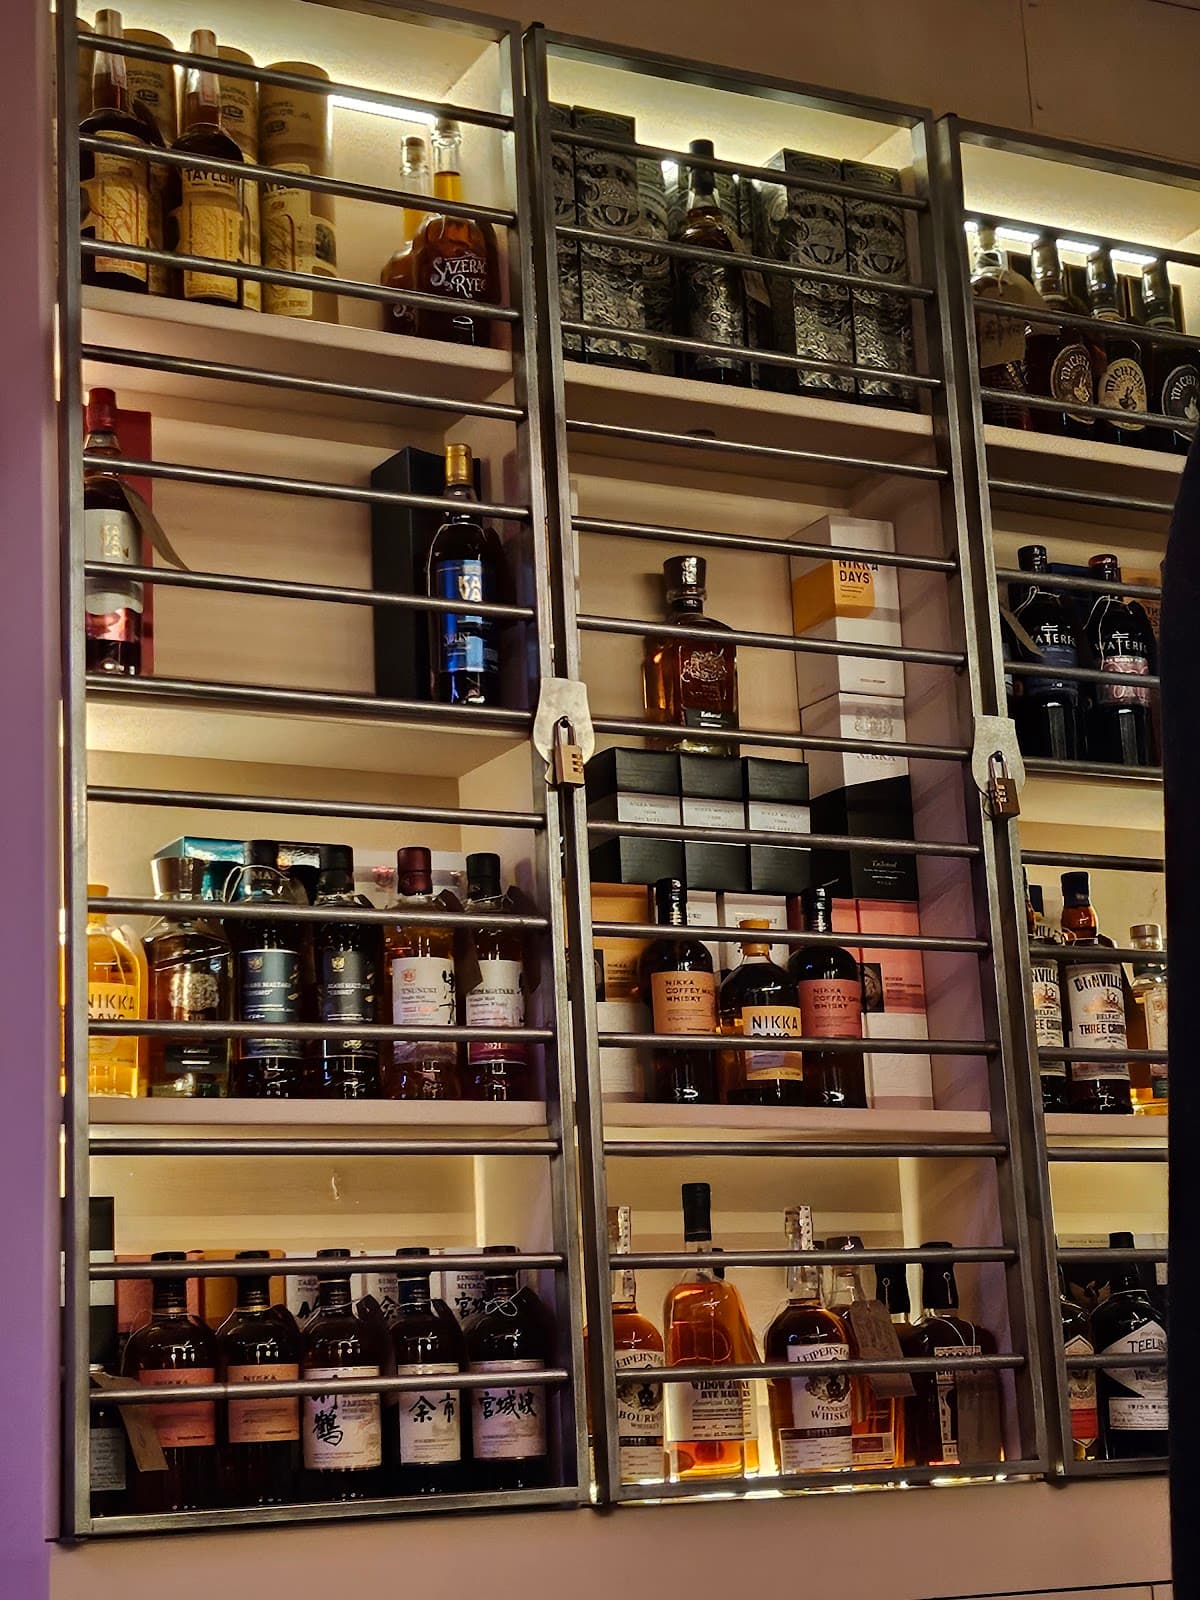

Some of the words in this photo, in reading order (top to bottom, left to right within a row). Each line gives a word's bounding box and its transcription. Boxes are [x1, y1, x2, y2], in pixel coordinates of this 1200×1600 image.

[839, 570, 869, 584] DAYS
[88, 993, 134, 1010] NIKKA
[752, 1016, 798, 1030] NIKKA
[1079, 1024, 1106, 1034] THREE
[409, 1392, 457, 1423] 余市
